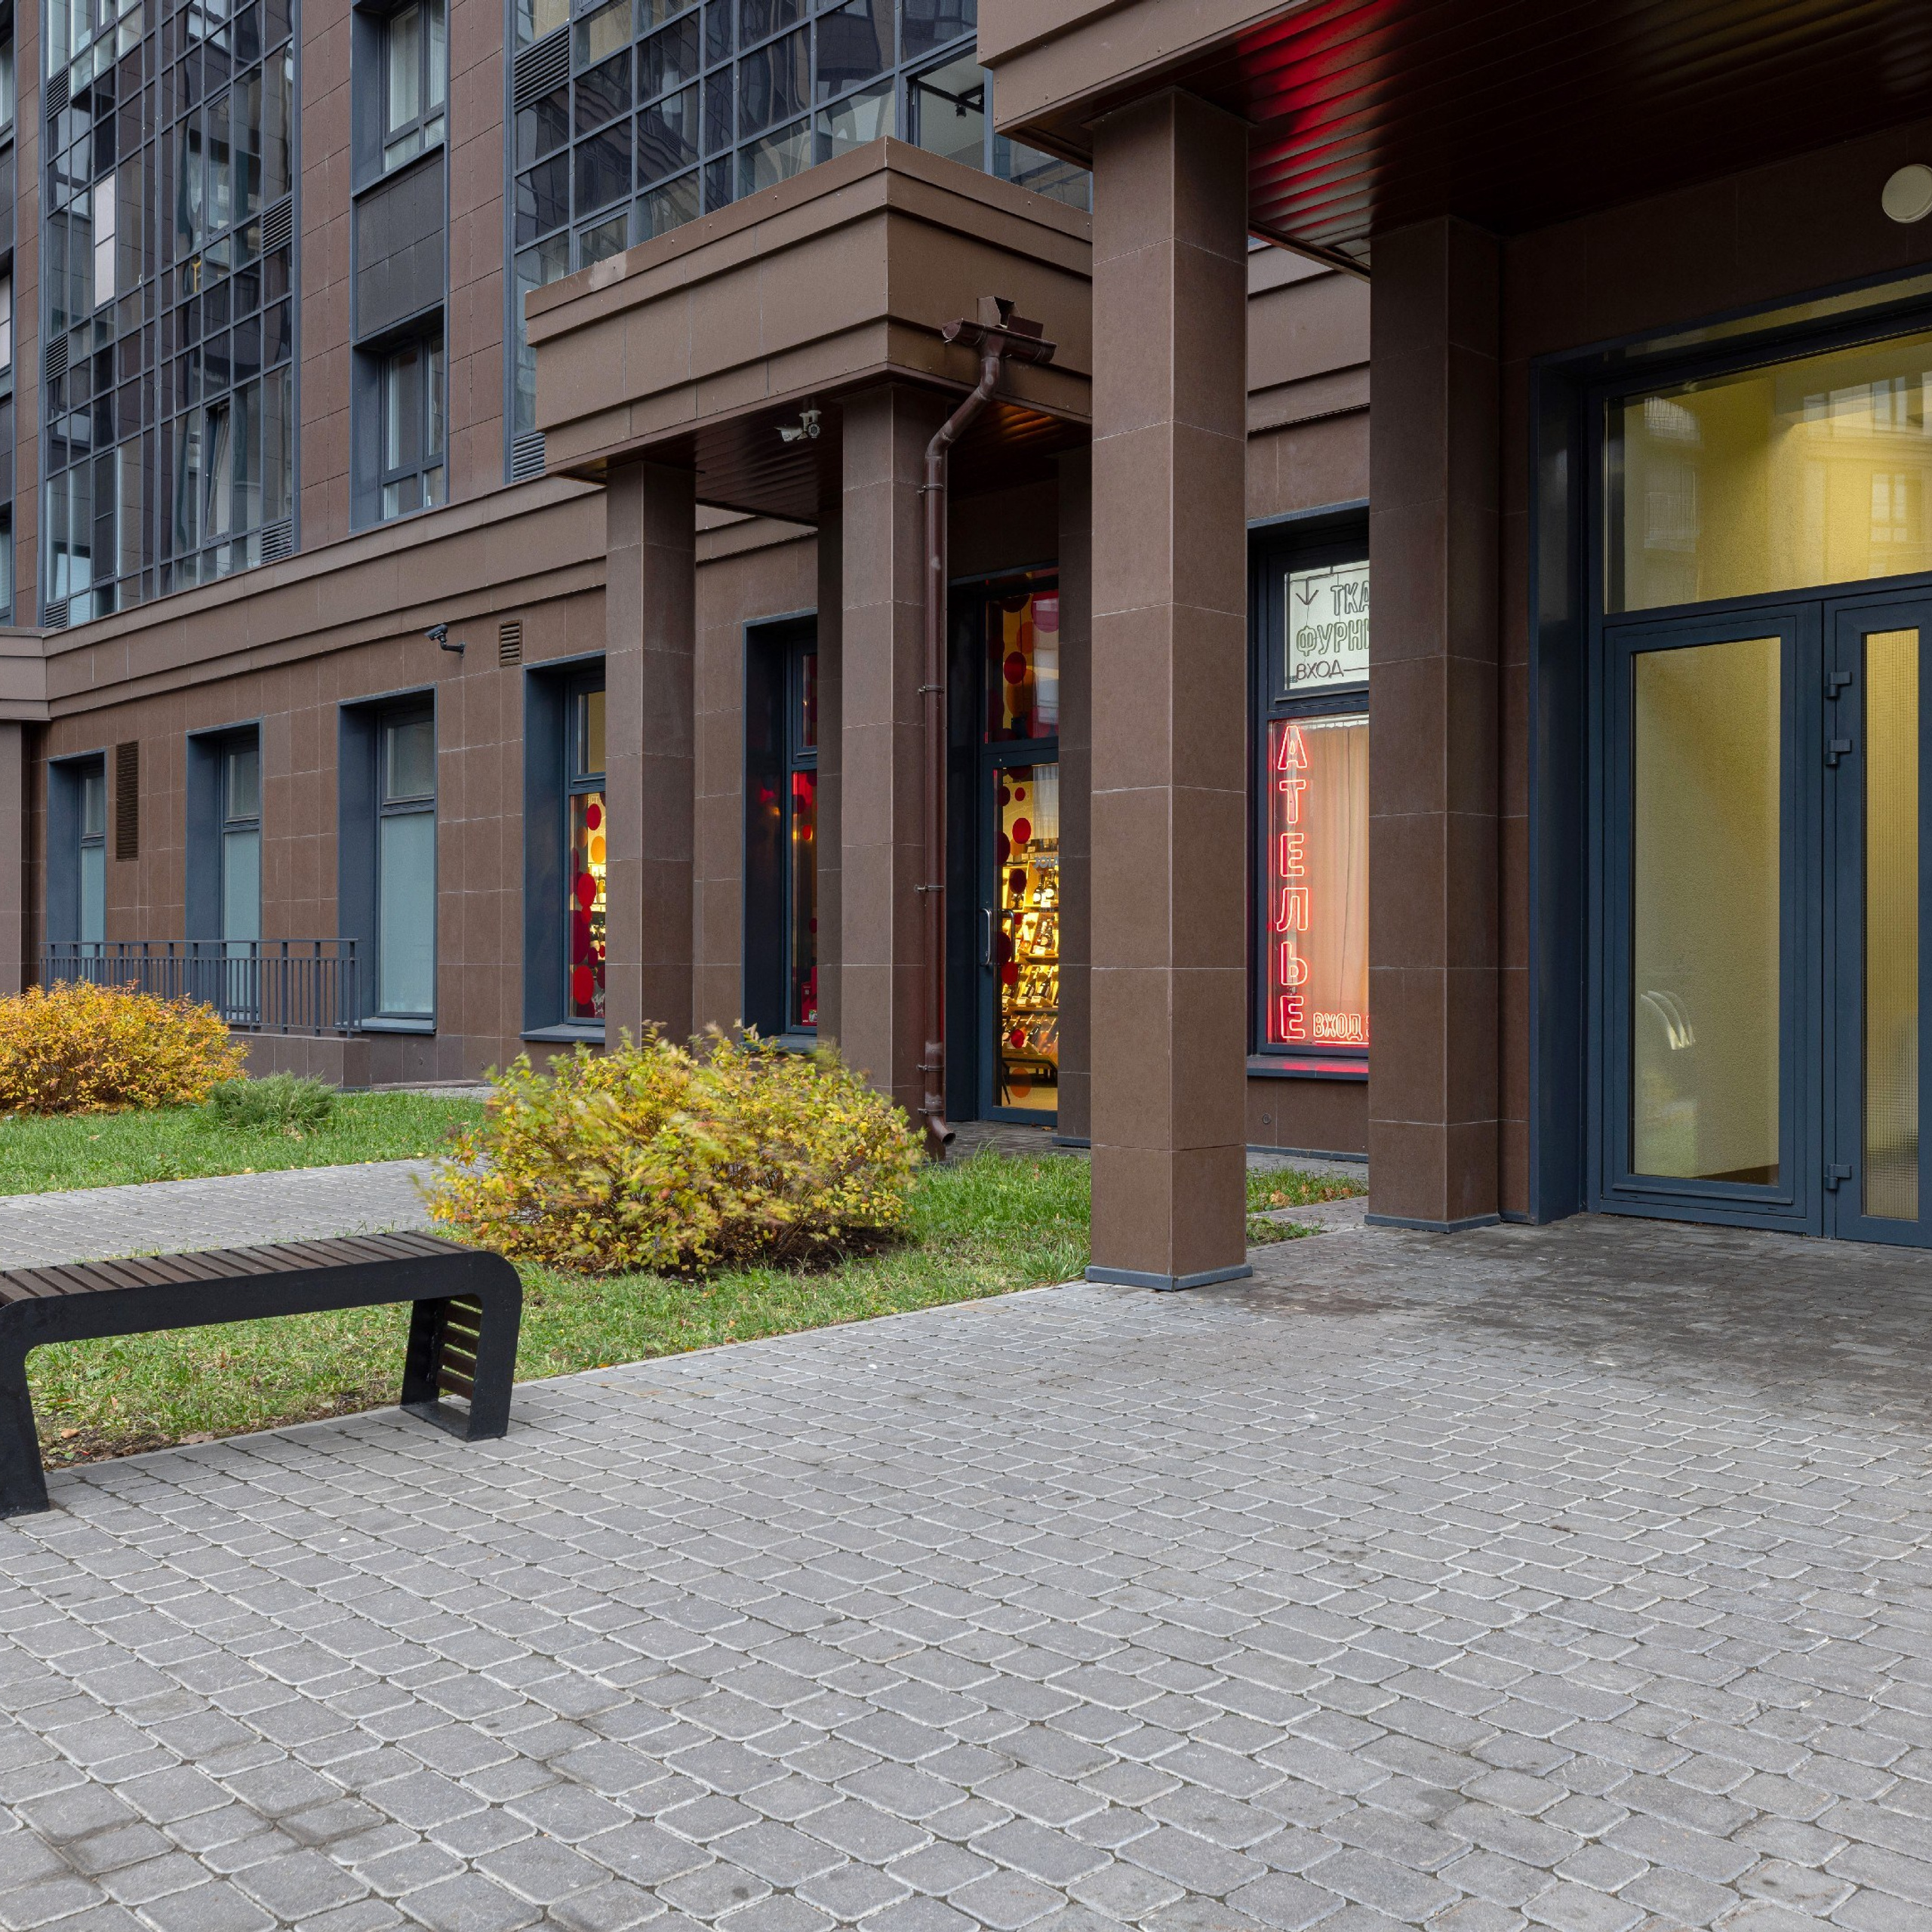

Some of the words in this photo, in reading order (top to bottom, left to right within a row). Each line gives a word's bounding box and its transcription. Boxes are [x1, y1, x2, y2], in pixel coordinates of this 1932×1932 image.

[1296, 660, 1344, 680] ВХОД
[1276, 724, 1309, 1040] АТЕЛЬЕ
[1313, 1012, 1363, 1041] ВХОД
